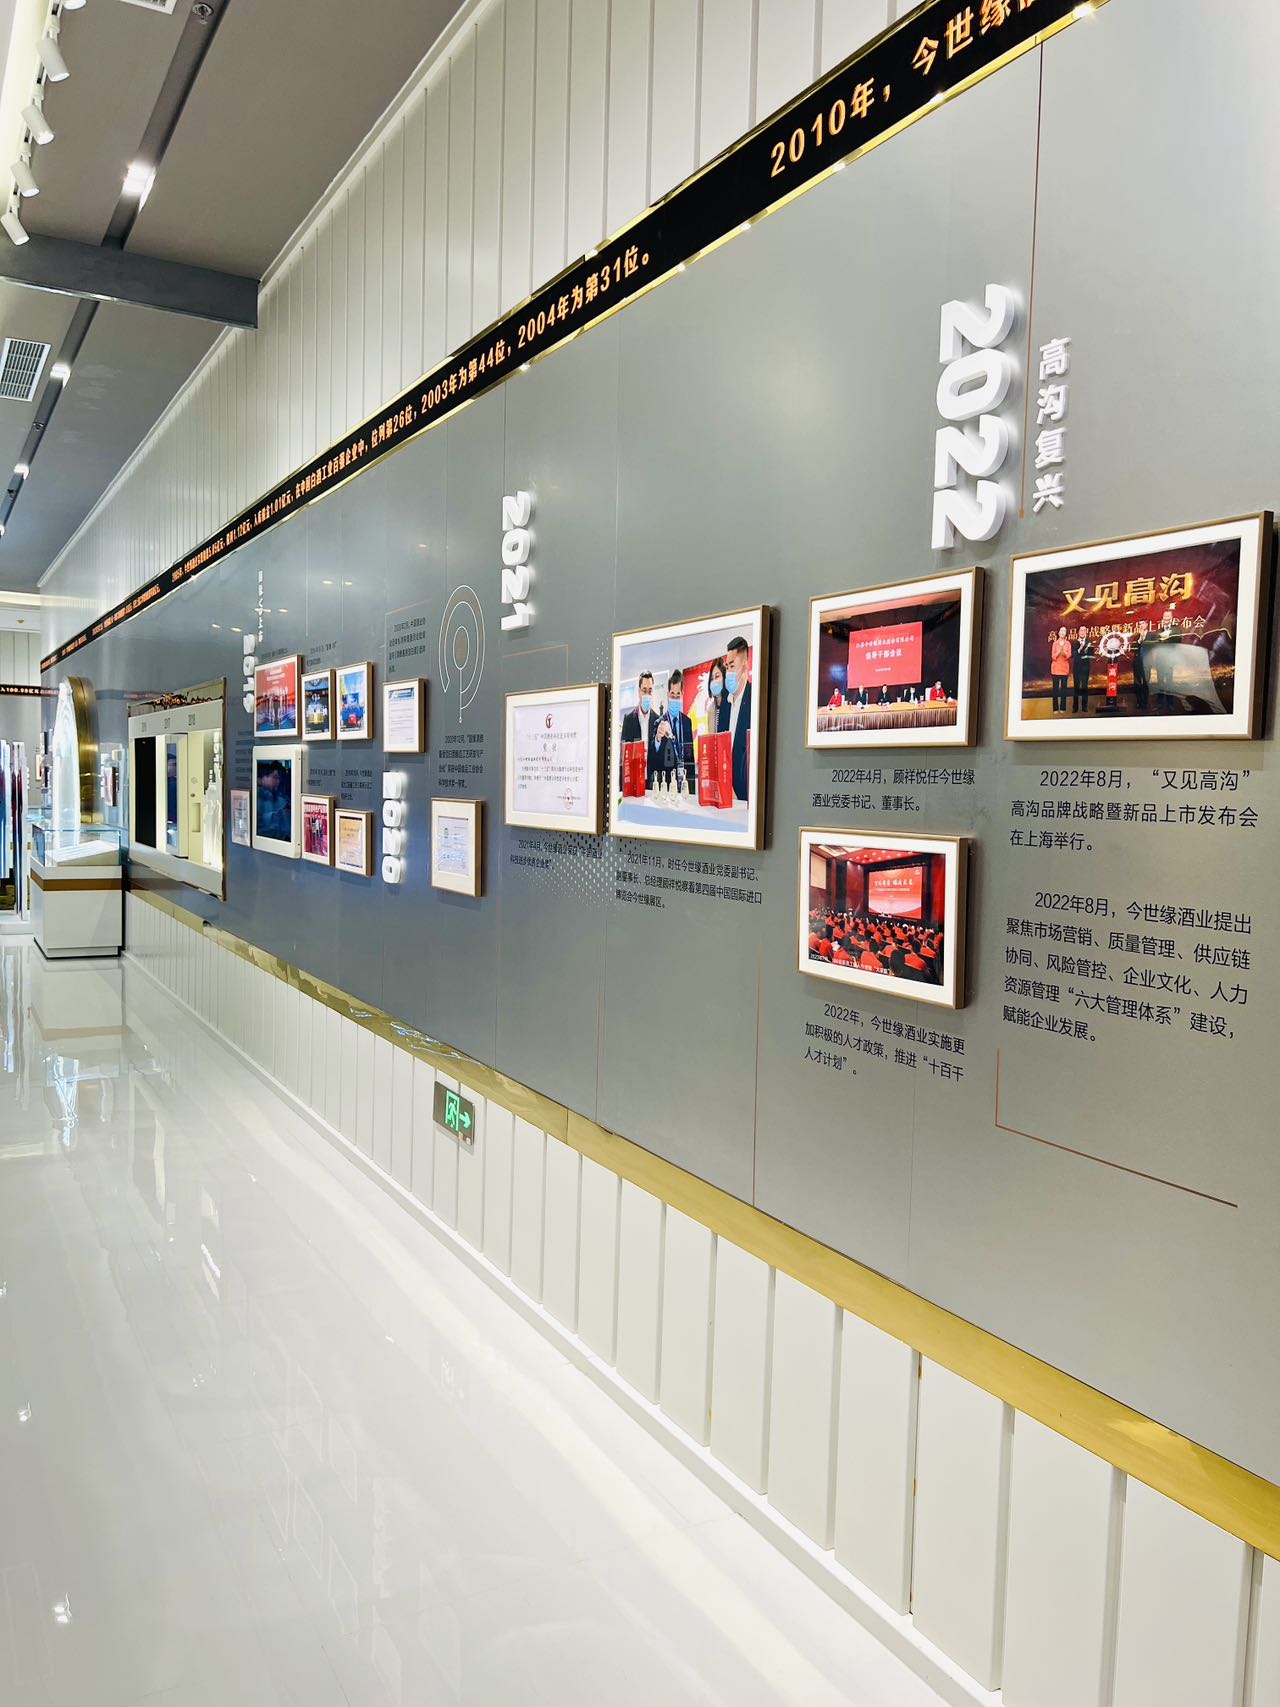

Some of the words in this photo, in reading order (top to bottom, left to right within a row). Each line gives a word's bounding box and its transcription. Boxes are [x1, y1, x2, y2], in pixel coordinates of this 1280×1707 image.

[770, 0, 1035, 178] 2010年，今世缘
[931, 283, 1014, 550] 2022
[1032, 336, 1072, 513] 高沟复兴
[500, 490, 531, 631] 2021
[1059, 571, 1194, 617] 又见高沟
[831, 768, 975, 785] 2022年4月，顾祥悦任今世缘
[1039, 769, 1250, 791] 2022年8月，“又见高沟”
[382, 771, 402, 883] 2020
[812, 793, 921, 812] 酒业党委书记、董事长。
[1011, 799, 1259, 827] 高沟品牌战略暨新品上市发布会
[1009, 829, 1093, 850] 在上海举行。
[627, 853, 760, 882] 2021年11月，时任今世缘酒业党委副书记、
[1034, 891, 1252, 935] 2022年8月，今世缘酒业提出
[1006, 917, 1251, 970] 聚焦市场营销、质量管理、供应链
[1005, 946, 1249, 1005] 协同、风险管控、企业文化、人力
[823, 1003, 966, 1056] 2022年，今世缘酒业实施更
[1002, 1005, 1098, 1042] 赋能企业发展。
[1003, 975, 1236, 1039] 资源管理“六大管理体系”建设，
[804, 1021, 965, 1083] 加积极的人才政策，推进“十百千
[804, 1048, 858, 1076] 人才计划”。
